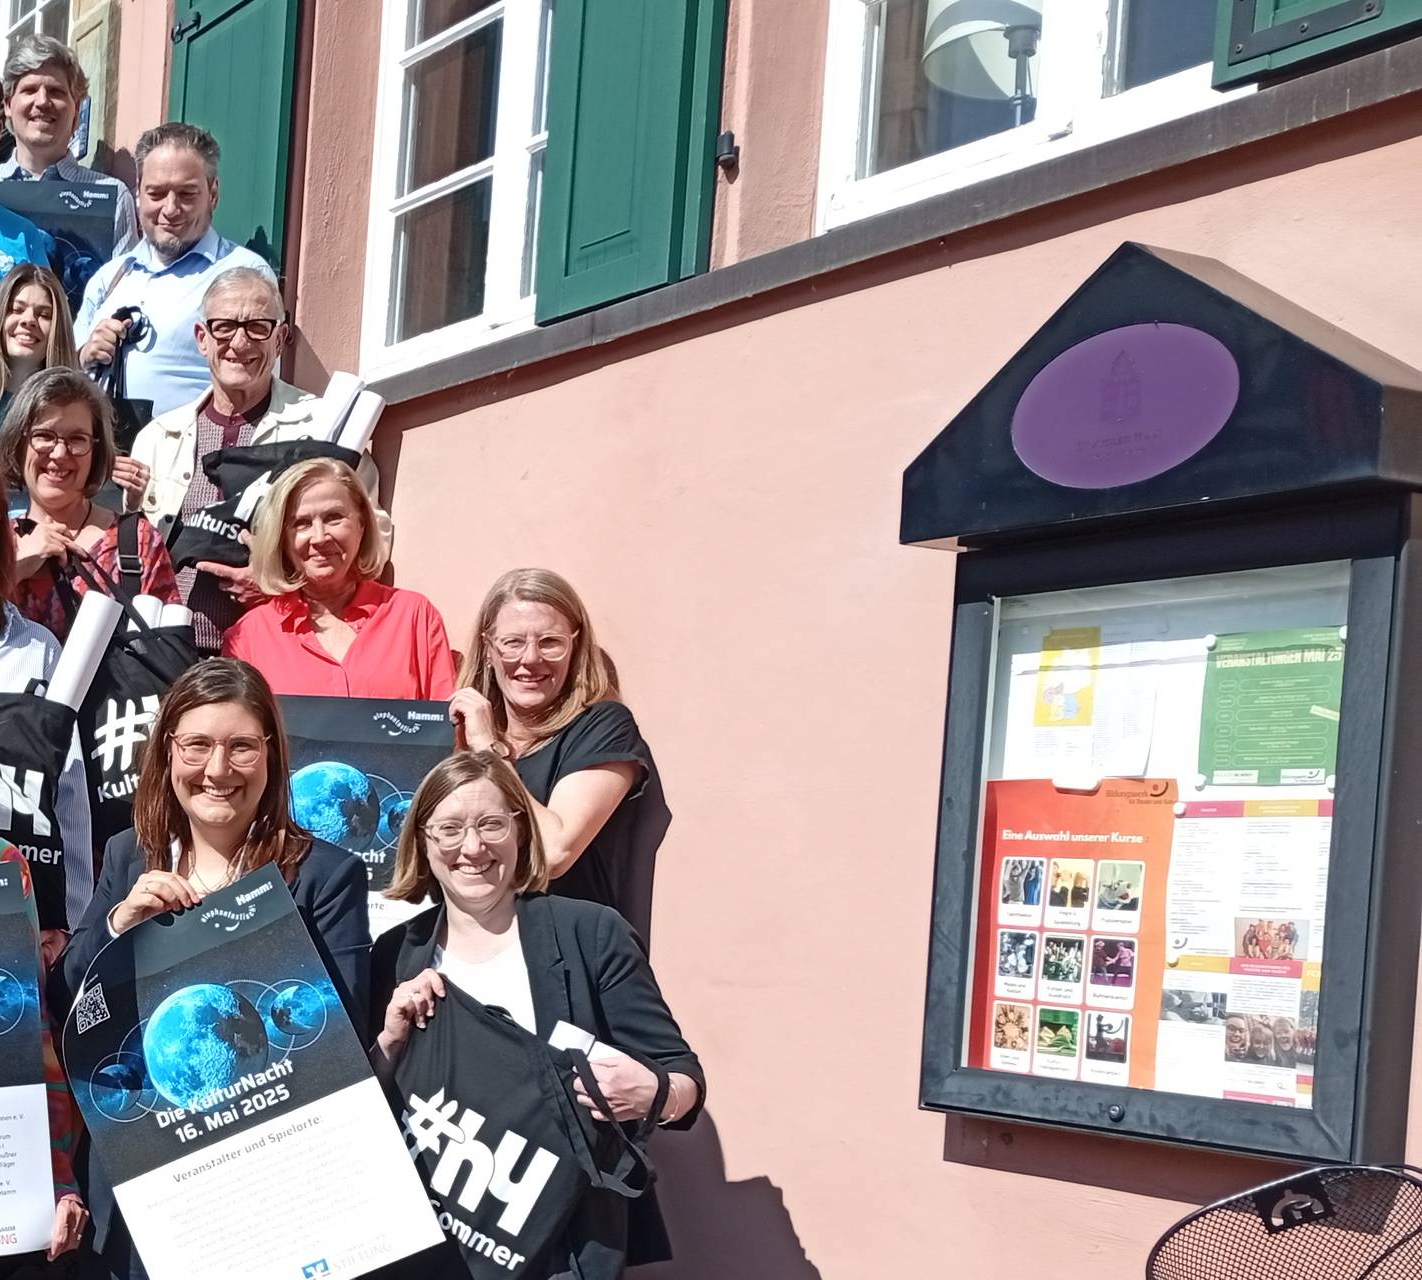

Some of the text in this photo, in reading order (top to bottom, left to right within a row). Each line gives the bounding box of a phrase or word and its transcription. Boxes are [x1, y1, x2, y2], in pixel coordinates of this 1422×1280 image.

[1303, 647, 1326, 663] MAI
[1327, 646, 1343, 662] 25
[407, 711, 444, 722] Hamm:
[1002, 829, 1143, 844] Eine Auswahl unserer Kurse
[235, 881, 274, 906] Hamm:
[155, 1058, 294, 1129] Die KulturNacht
[175, 1083, 291, 1144] 16. Mai 2025
[172, 1115, 324, 1183] Veranstalter und Spielorte:
